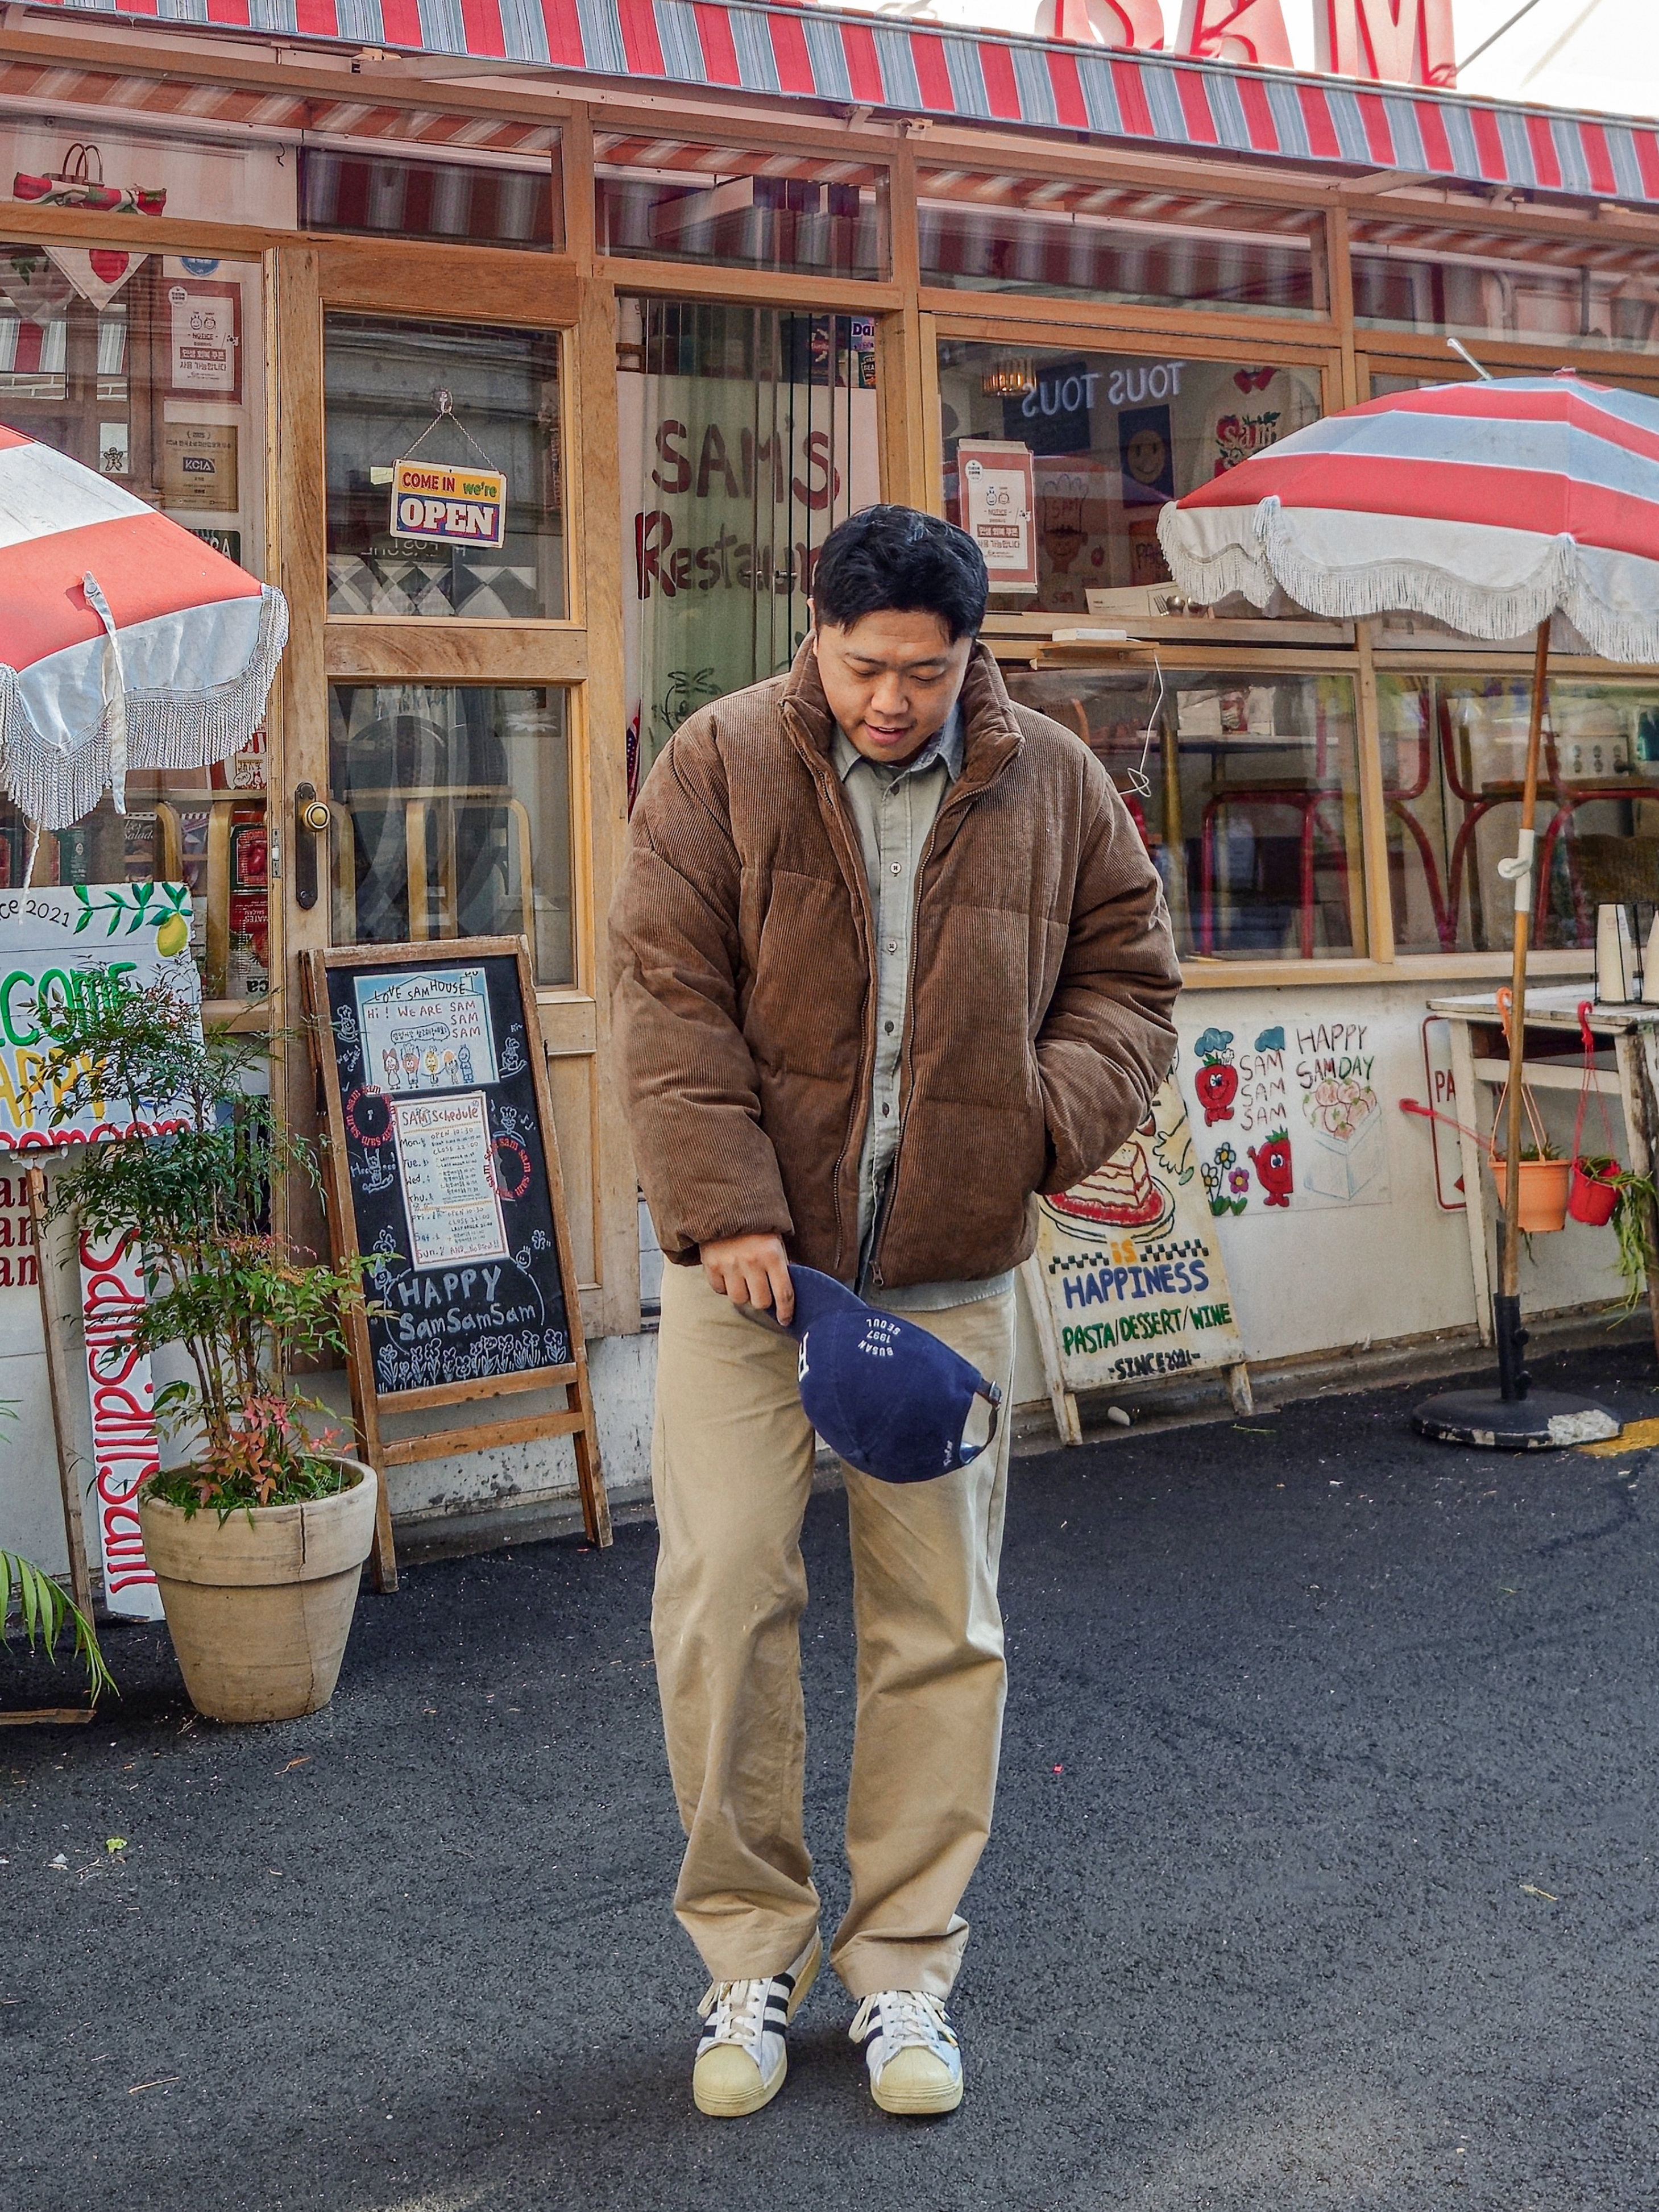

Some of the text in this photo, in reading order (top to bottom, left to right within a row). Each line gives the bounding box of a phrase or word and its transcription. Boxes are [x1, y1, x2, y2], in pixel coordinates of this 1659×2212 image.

[185, 459, 211, 471] KCIA
[402, 471, 497, 498] COME IN we're
[399, 497, 496, 537] OPEN
[26, 899, 69, 927] 2021
[375, 980, 465, 1003] LOVE SAM HOUSE
[420, 1003, 442, 1016] ARE
[450, 1001, 476, 1012] SAM
[451, 1012, 479, 1024] SAM
[452, 1026, 481, 1039] SAM
[1296, 1023, 1367, 1055] HAPPY
[1239, 1049, 1284, 1081] SAM
[1241, 1077, 1285, 1107] SAM
[432, 1105, 479, 1122] Schedule
[1241, 1102, 1286, 1131] SAM
[431, 1130, 450, 1140] OPEN
[433, 1146, 454, 1155] CLOSE
[398, 1265, 501, 1309] HAPPY
[1062, 1259, 1210, 1309] HAPPINESS
[866, 1318, 901, 1336] SEOUL
[866, 1330, 891, 1343] 1997
[857, 1339, 894, 1356] BUSAN
